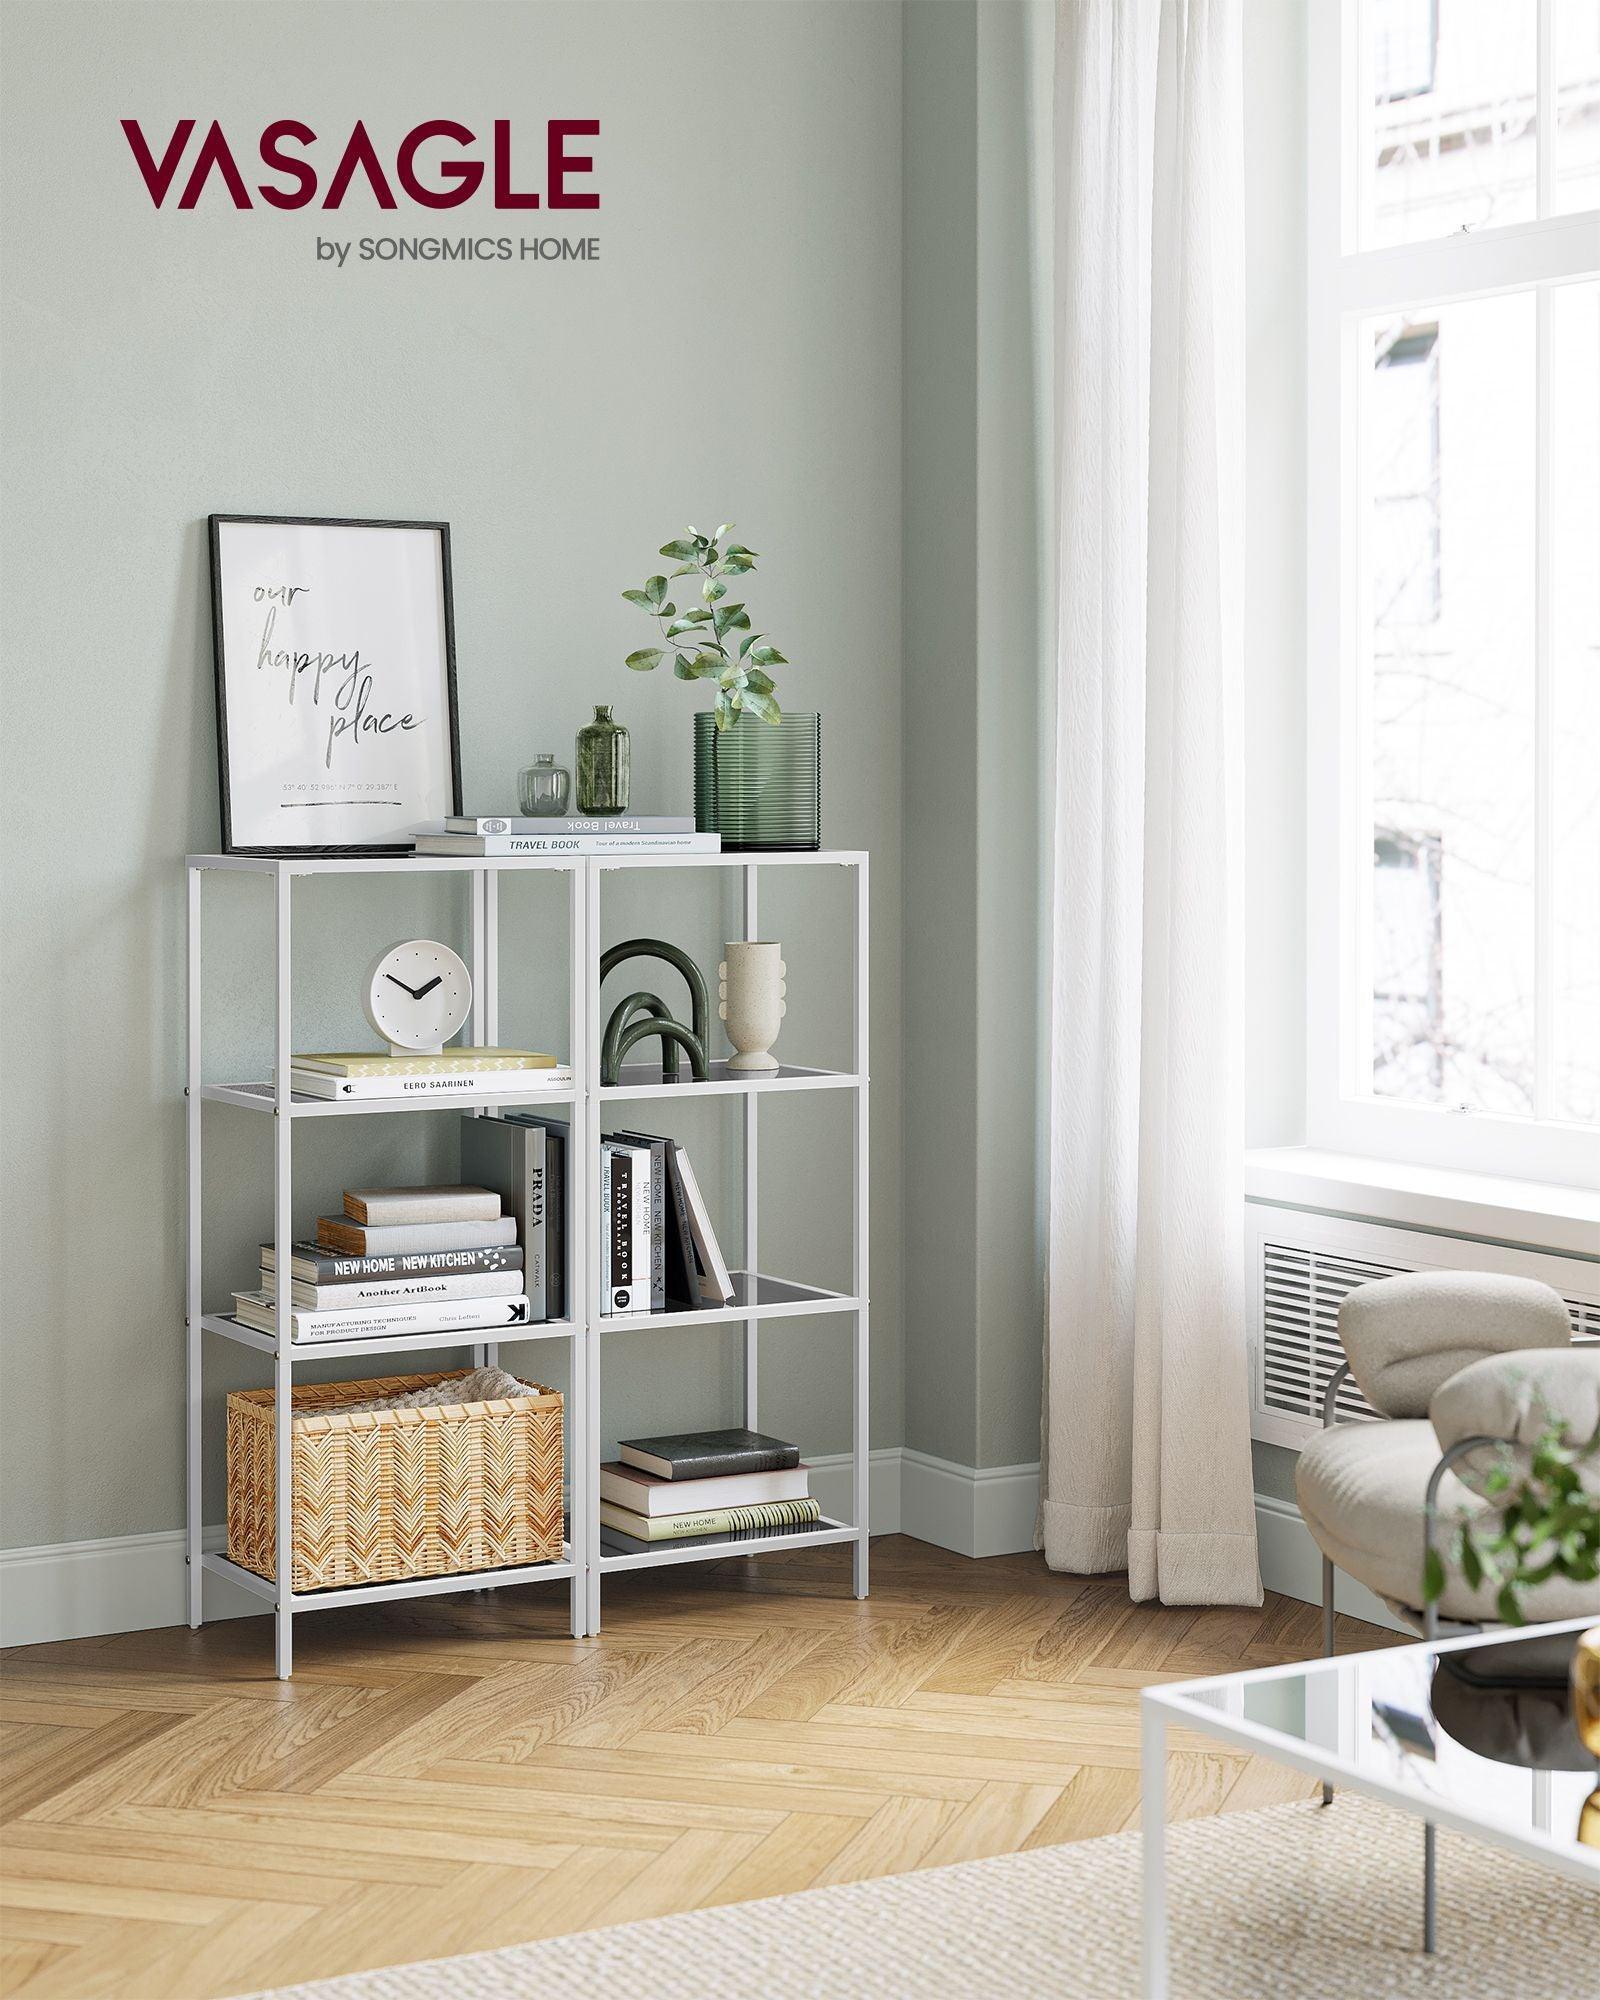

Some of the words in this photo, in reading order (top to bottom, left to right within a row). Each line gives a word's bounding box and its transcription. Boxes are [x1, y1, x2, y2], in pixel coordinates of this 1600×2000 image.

[253, 584, 310, 607] our
[256, 605, 372, 711] happy
[325, 675, 426, 770] place
[567, 820, 600, 830] Book
[604, 821, 640, 831] Travel
[509, 840, 548, 850] TRAVEL
[551, 840, 580, 849] BOOK
[430, 1080, 474, 1088] SAARINEN
[654, 1154, 662, 1177] NEW
[532, 1167, 543, 1228] PRADA
[654, 1178, 662, 1204] HOME
[654, 1210, 662, 1232] NEW
[654, 1233, 662, 1270] KITCHEN
[334, 1260, 360, 1276] NEW
[362, 1258, 395, 1274] HOME
[402, 1254, 429, 1270] NEW
[430, 1252, 476, 1268] KITCHEN
[358, 1288, 400, 1298] Another
[403, 1284, 447, 1294] ArtBook
[310, 1320, 372, 1329] MANUFACTURING
[373, 1315, 416, 1324] TECHNIQUES
[326, 1327, 360, 1336] PRODUCT
[360, 1325, 387, 1333] DESIGN
[692, 1518, 716, 1526] HOME
